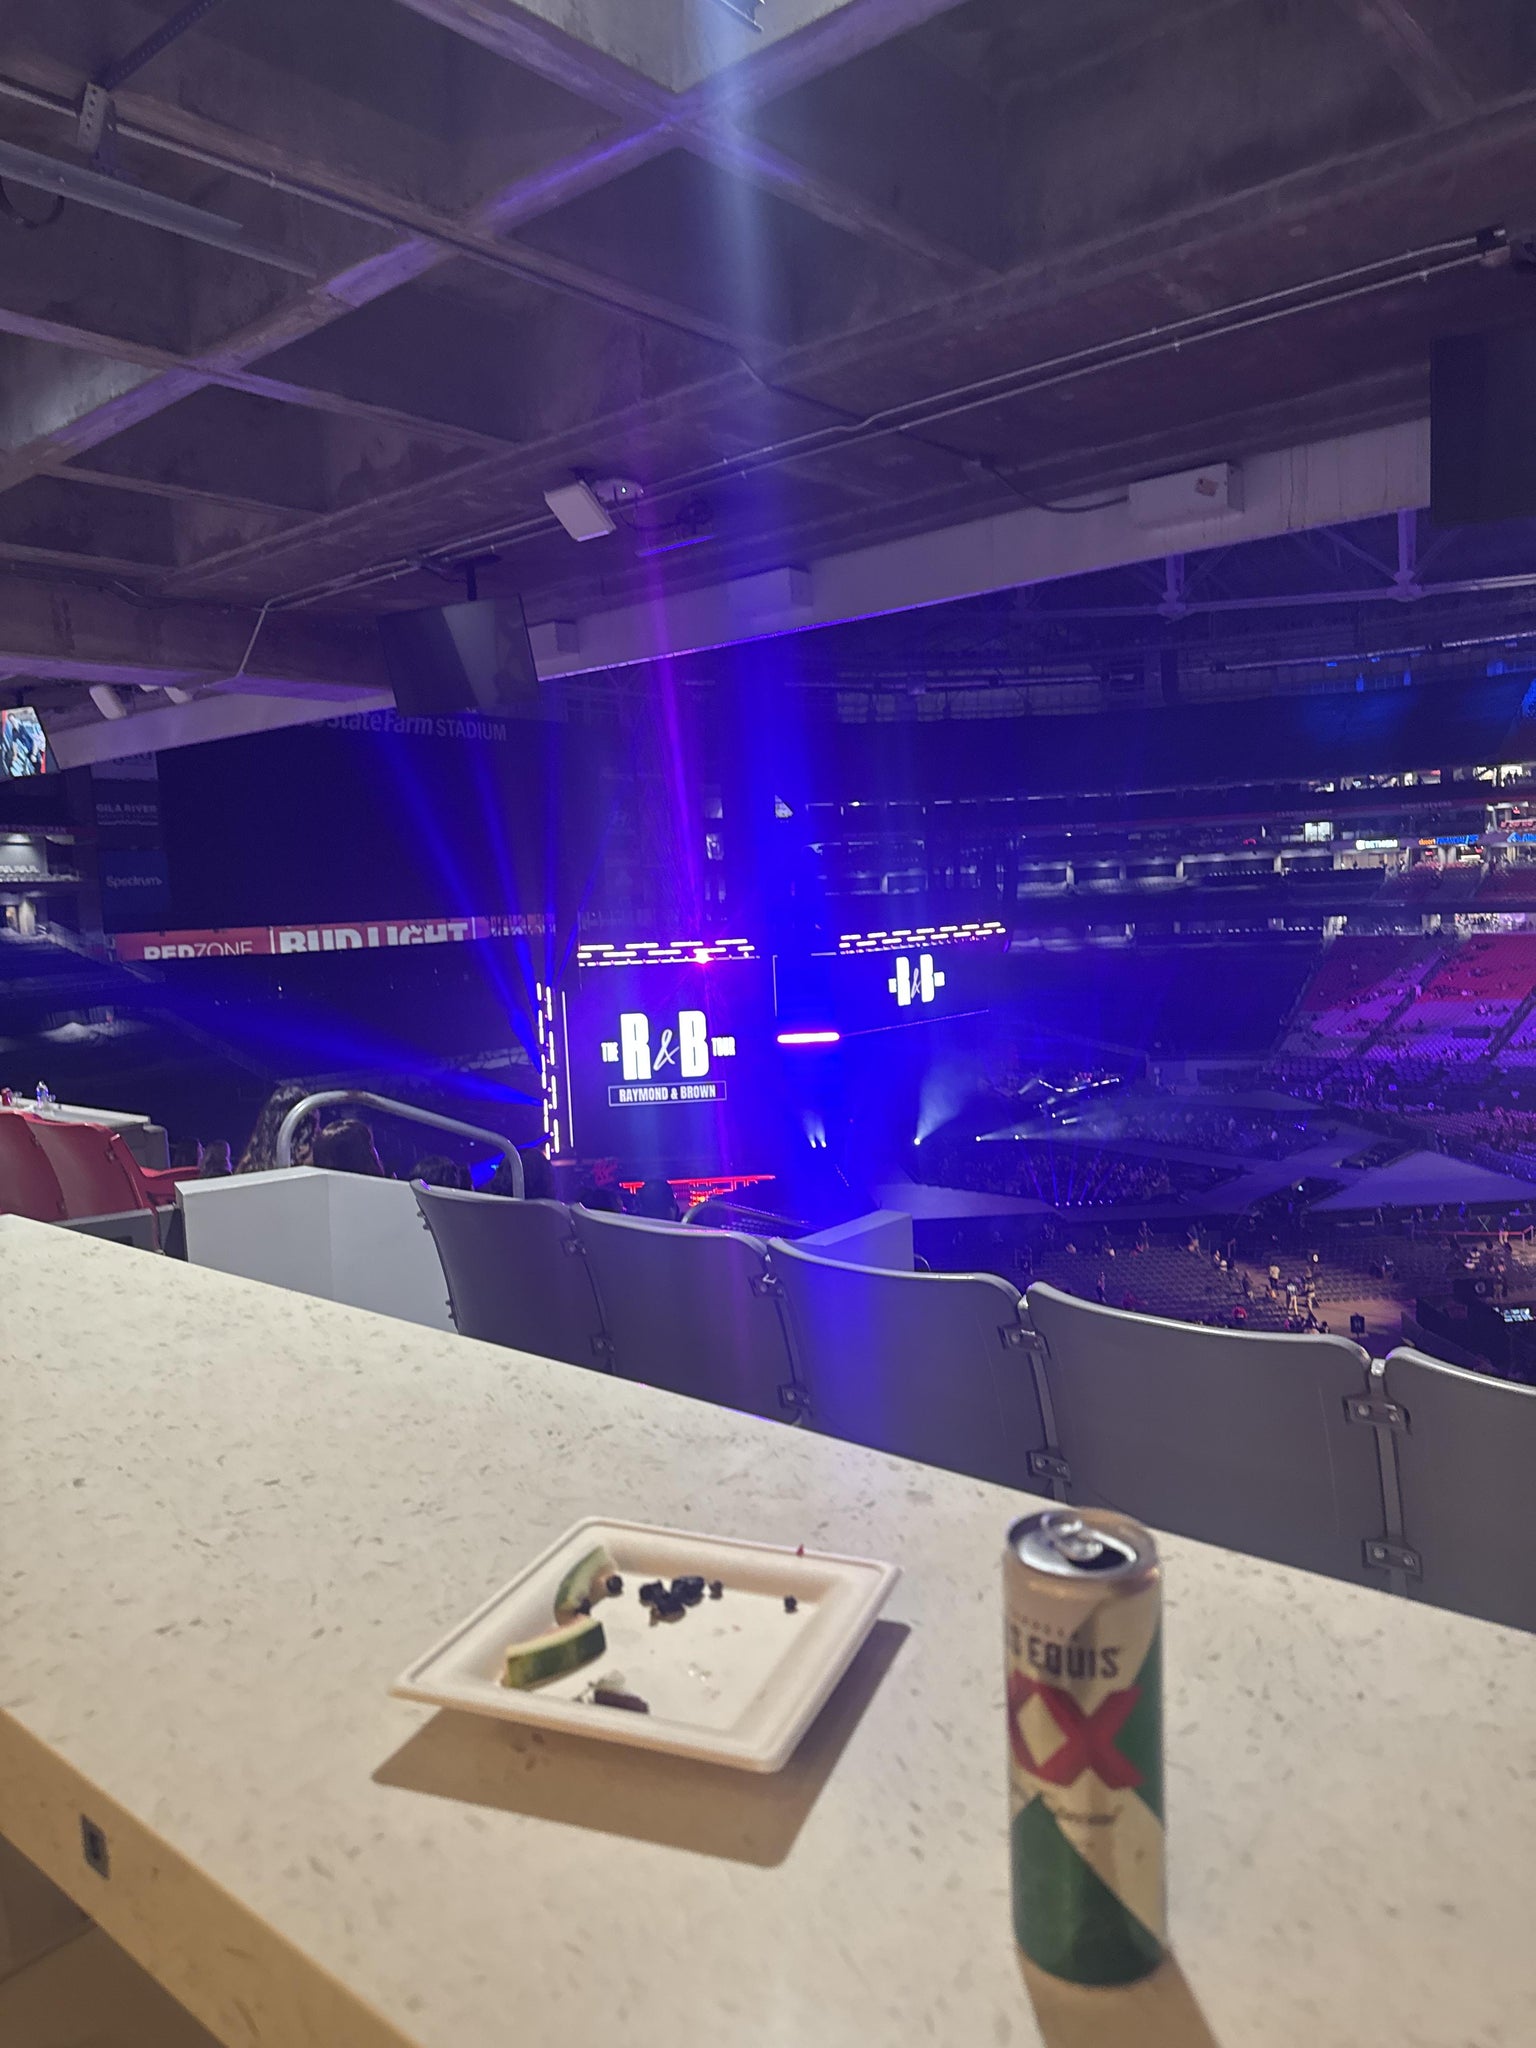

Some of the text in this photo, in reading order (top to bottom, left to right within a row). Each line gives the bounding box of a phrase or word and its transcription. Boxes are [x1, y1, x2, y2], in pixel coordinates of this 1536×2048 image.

[435, 718, 507, 742] STADIUM
[106, 875, 158, 889] Spectrum
[618, 1084, 716, 1103] RAYMOND & BROWN
